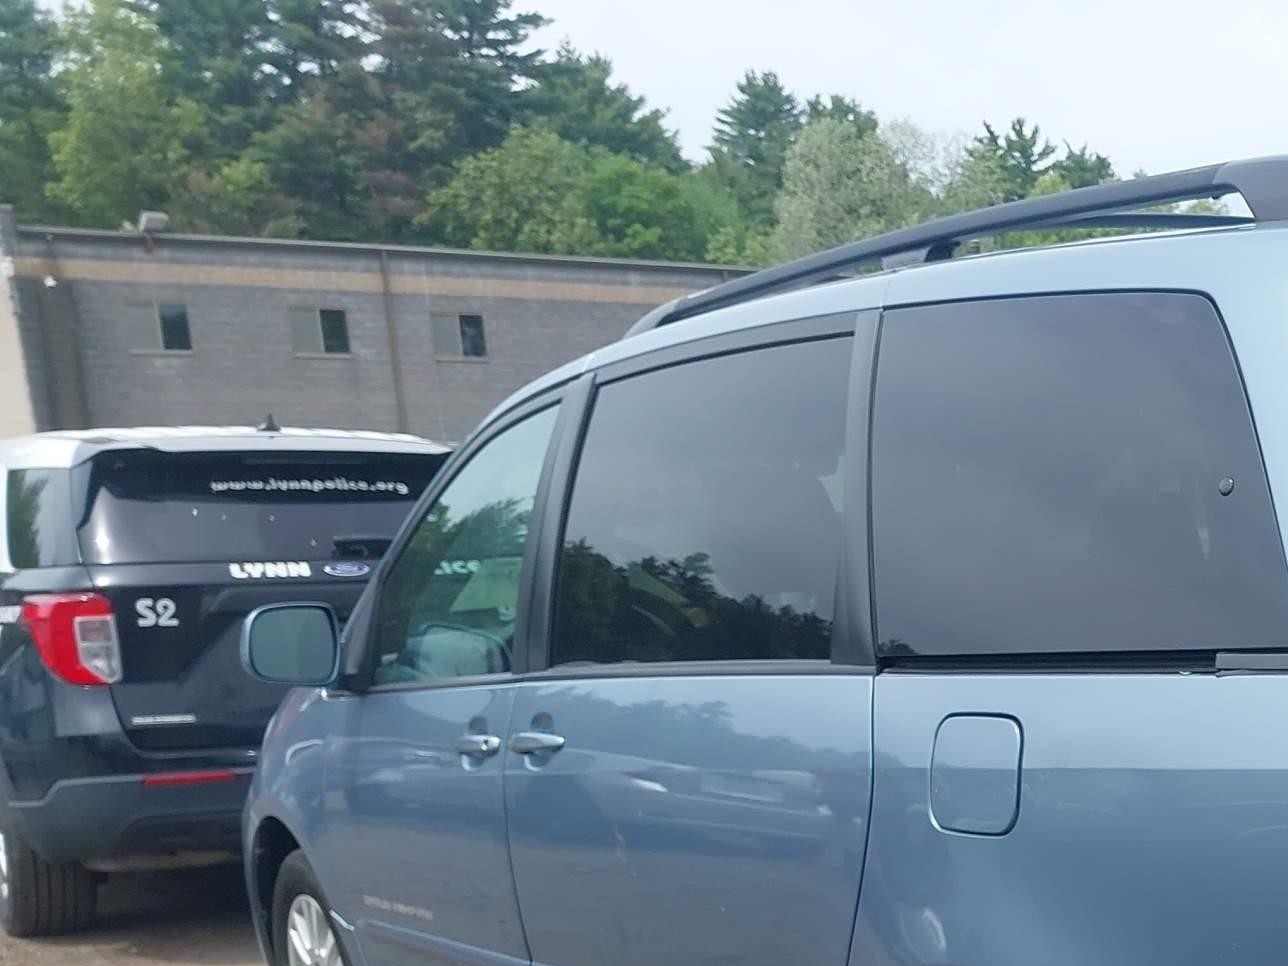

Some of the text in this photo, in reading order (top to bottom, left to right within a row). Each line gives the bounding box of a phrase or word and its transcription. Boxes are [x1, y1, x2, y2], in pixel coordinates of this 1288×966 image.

[210, 477, 409, 495] www.lynnpolice.org
[228, 560, 312, 579] LYNN
[135, 597, 180, 628] S2
